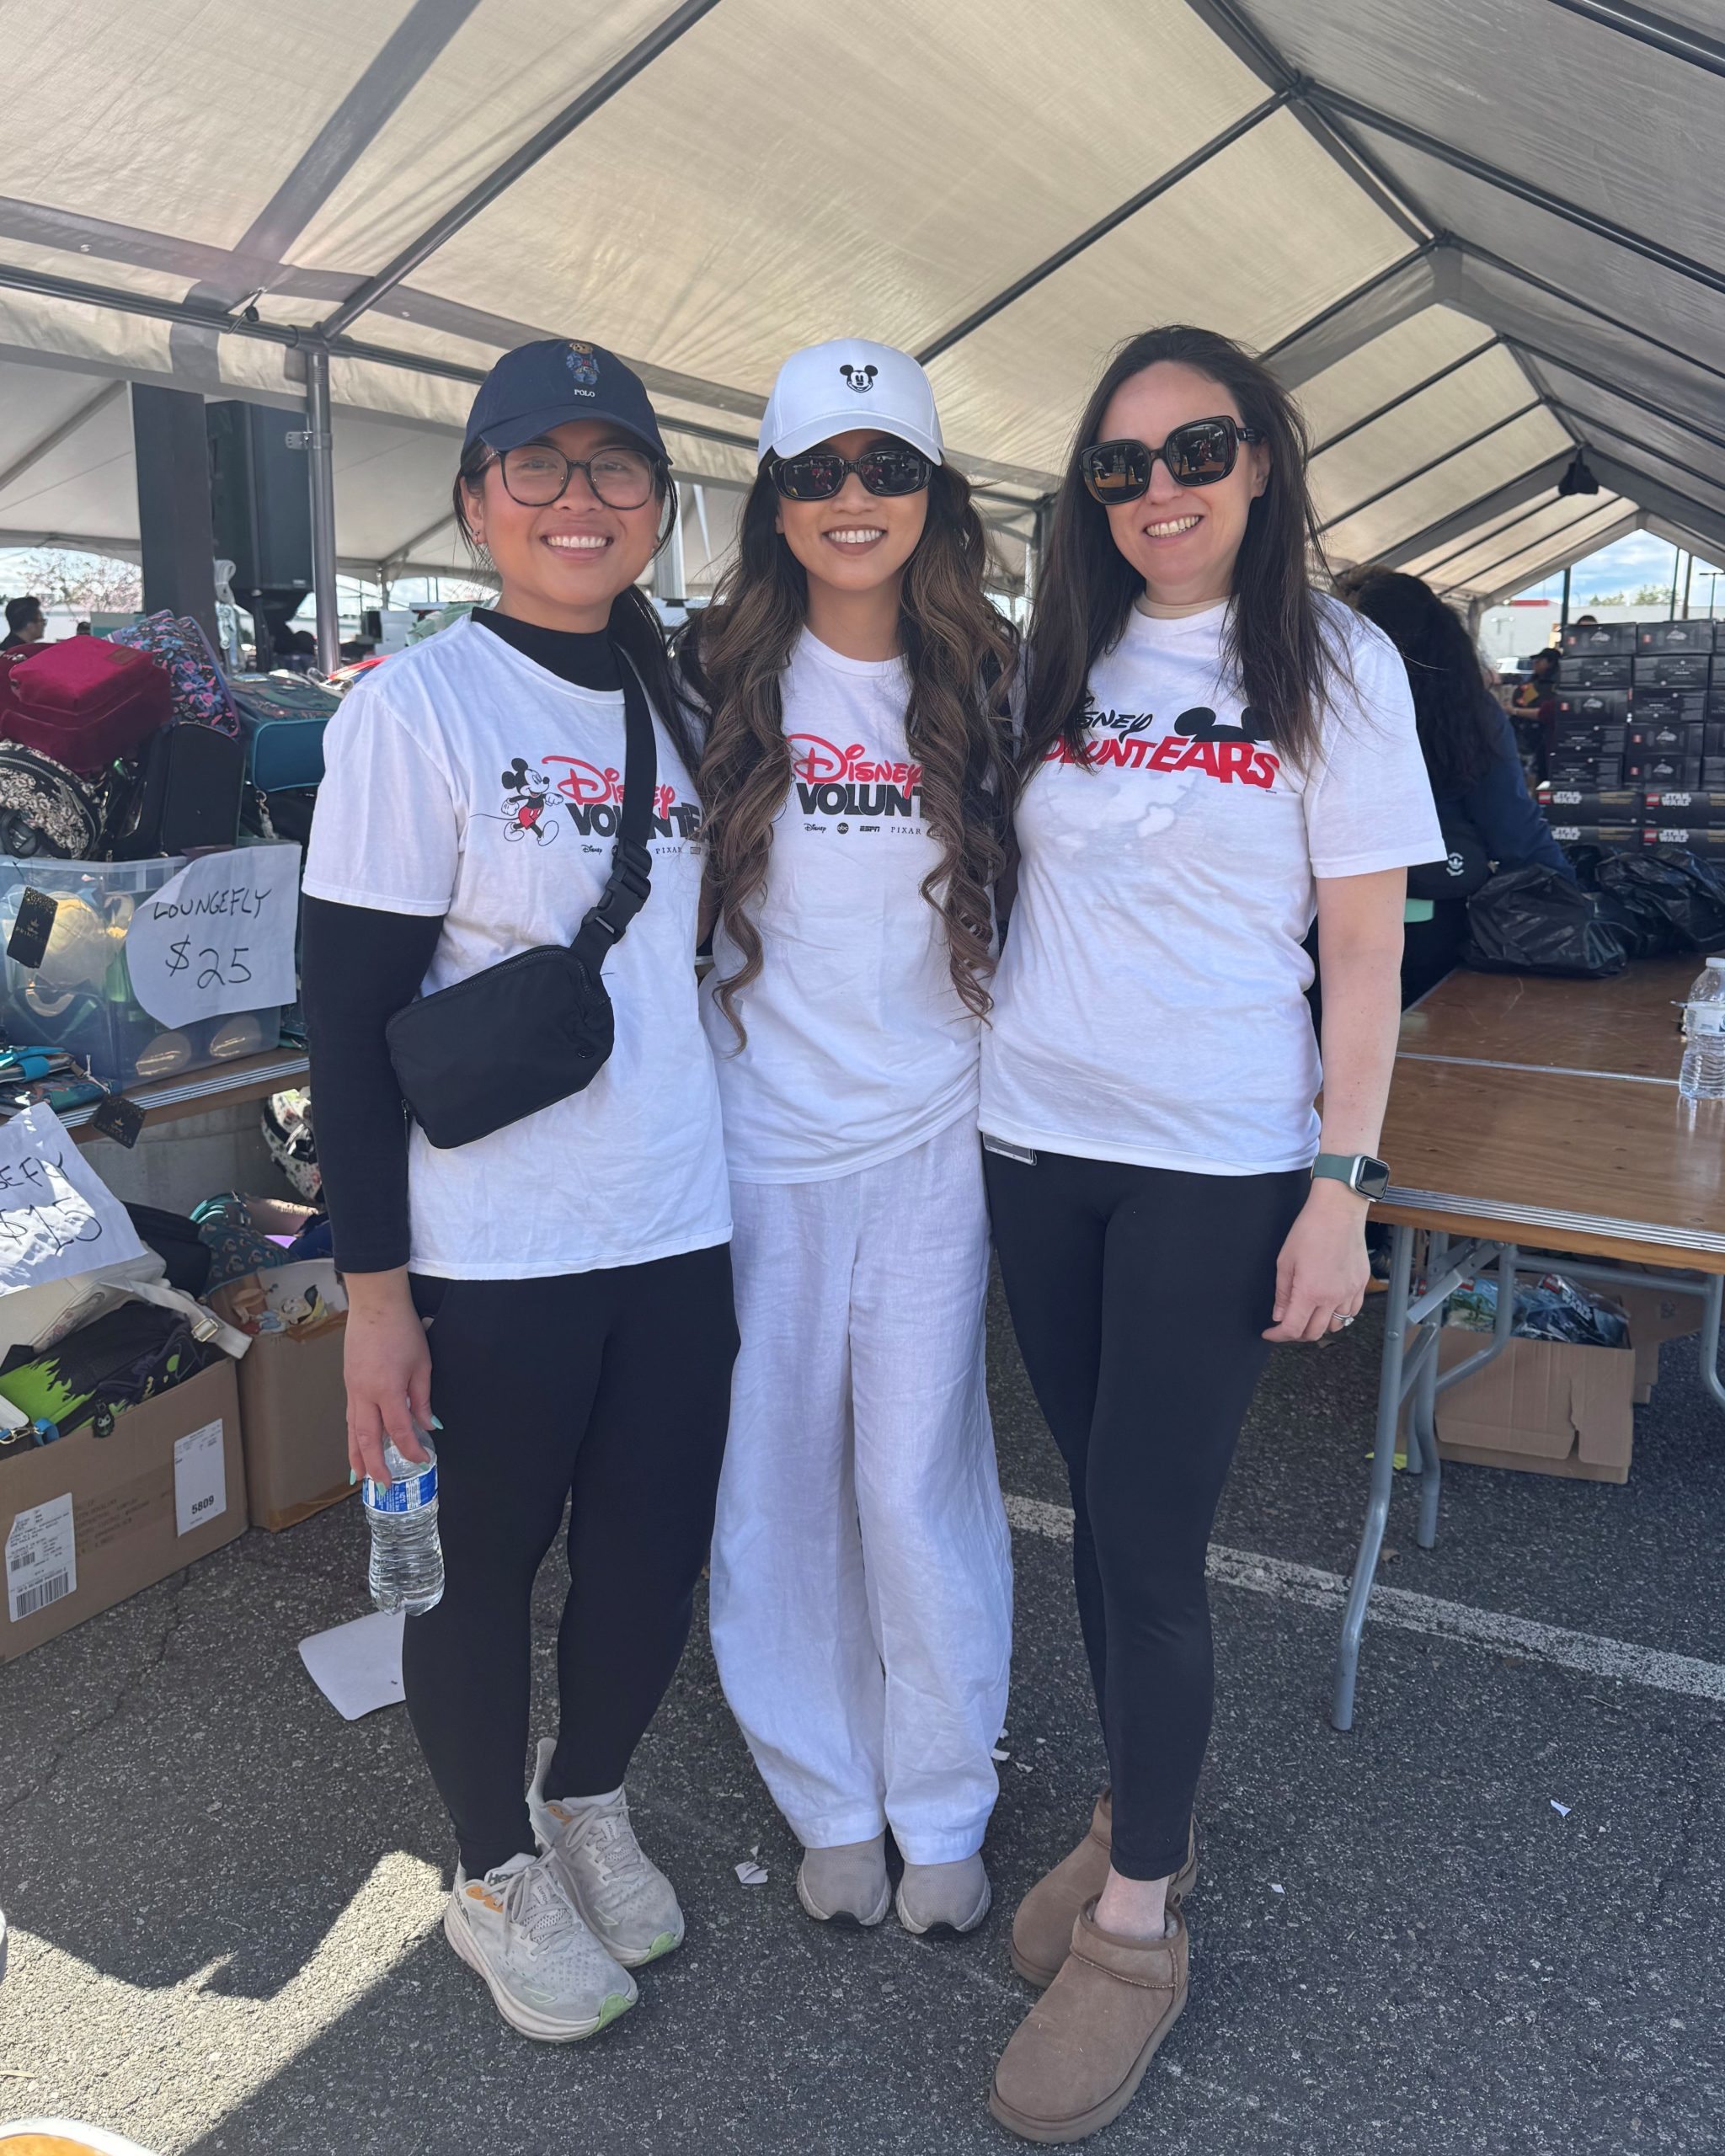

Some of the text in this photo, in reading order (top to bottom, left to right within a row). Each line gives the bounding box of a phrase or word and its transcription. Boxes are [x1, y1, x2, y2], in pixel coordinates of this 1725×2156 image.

[1039, 734, 1280, 789] OLUNTEARS
[891, 826, 921, 835] PIXAR
[153, 887, 272, 921] LOUNGEFLY
[191, 1495, 214, 1514] 5809
